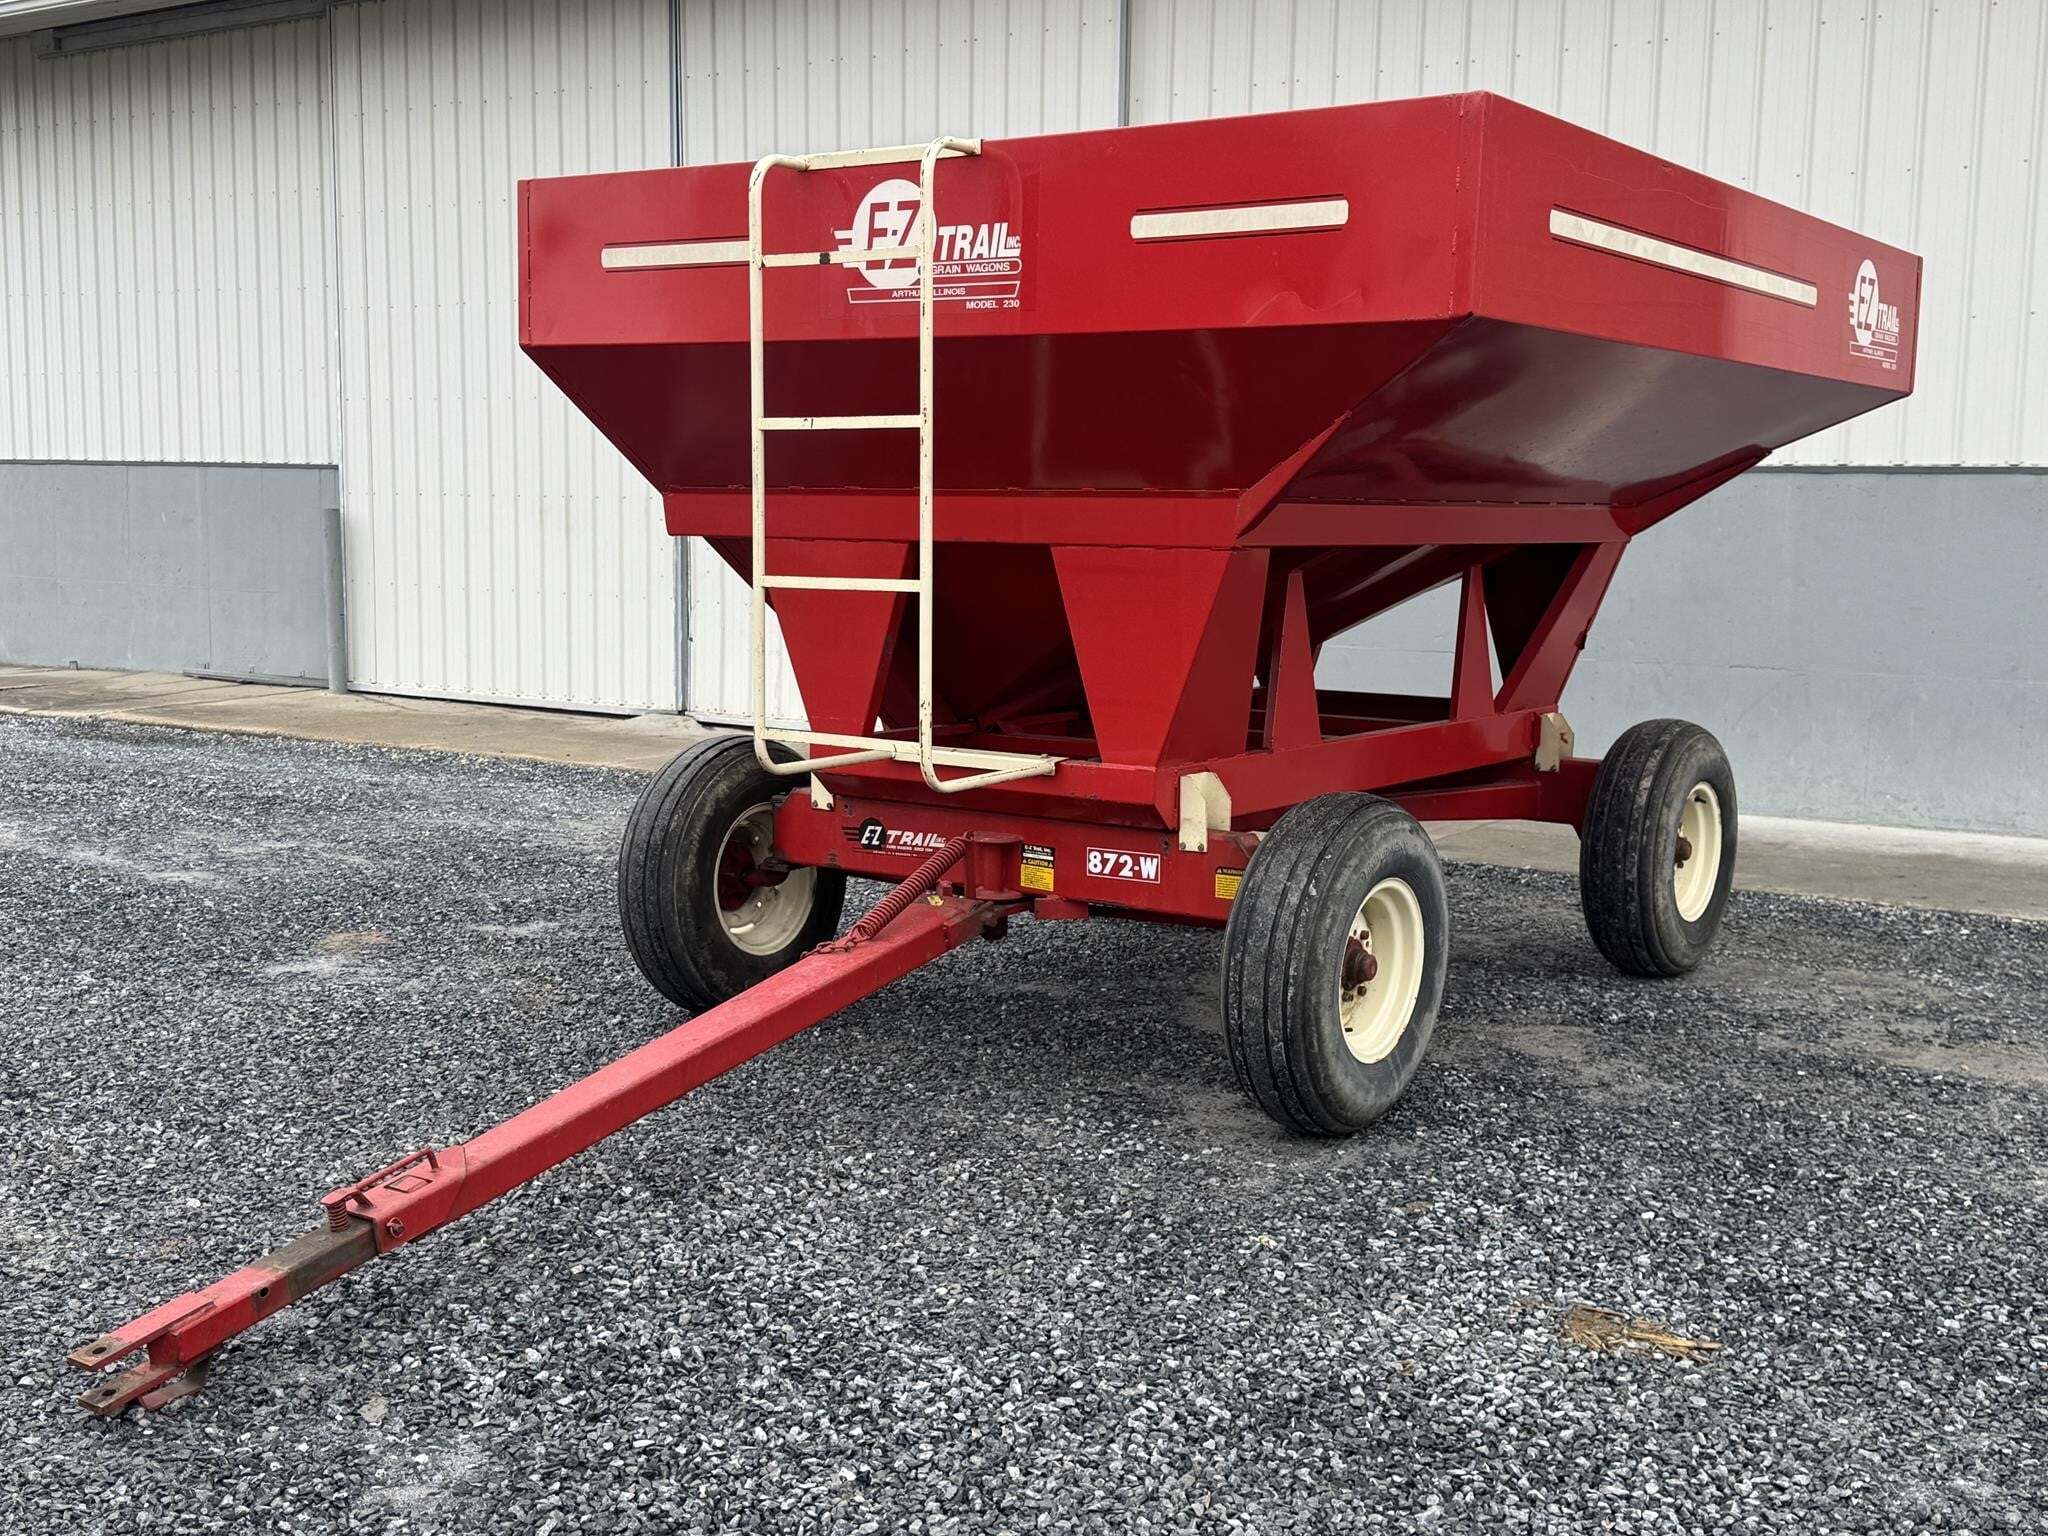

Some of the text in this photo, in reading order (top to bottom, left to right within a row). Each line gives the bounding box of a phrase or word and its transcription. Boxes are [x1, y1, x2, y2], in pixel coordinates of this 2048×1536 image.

[936, 222, 1021, 261] TRAIL
[932, 261, 1010, 275] GRAIN WAGONS
[891, 287, 966, 299] ARTHU LLINOIS
[966, 299, 1020, 310] MODEL 230
[886, 829, 946, 848] TRAIL
[1088, 850, 1158, 880] 872-W
